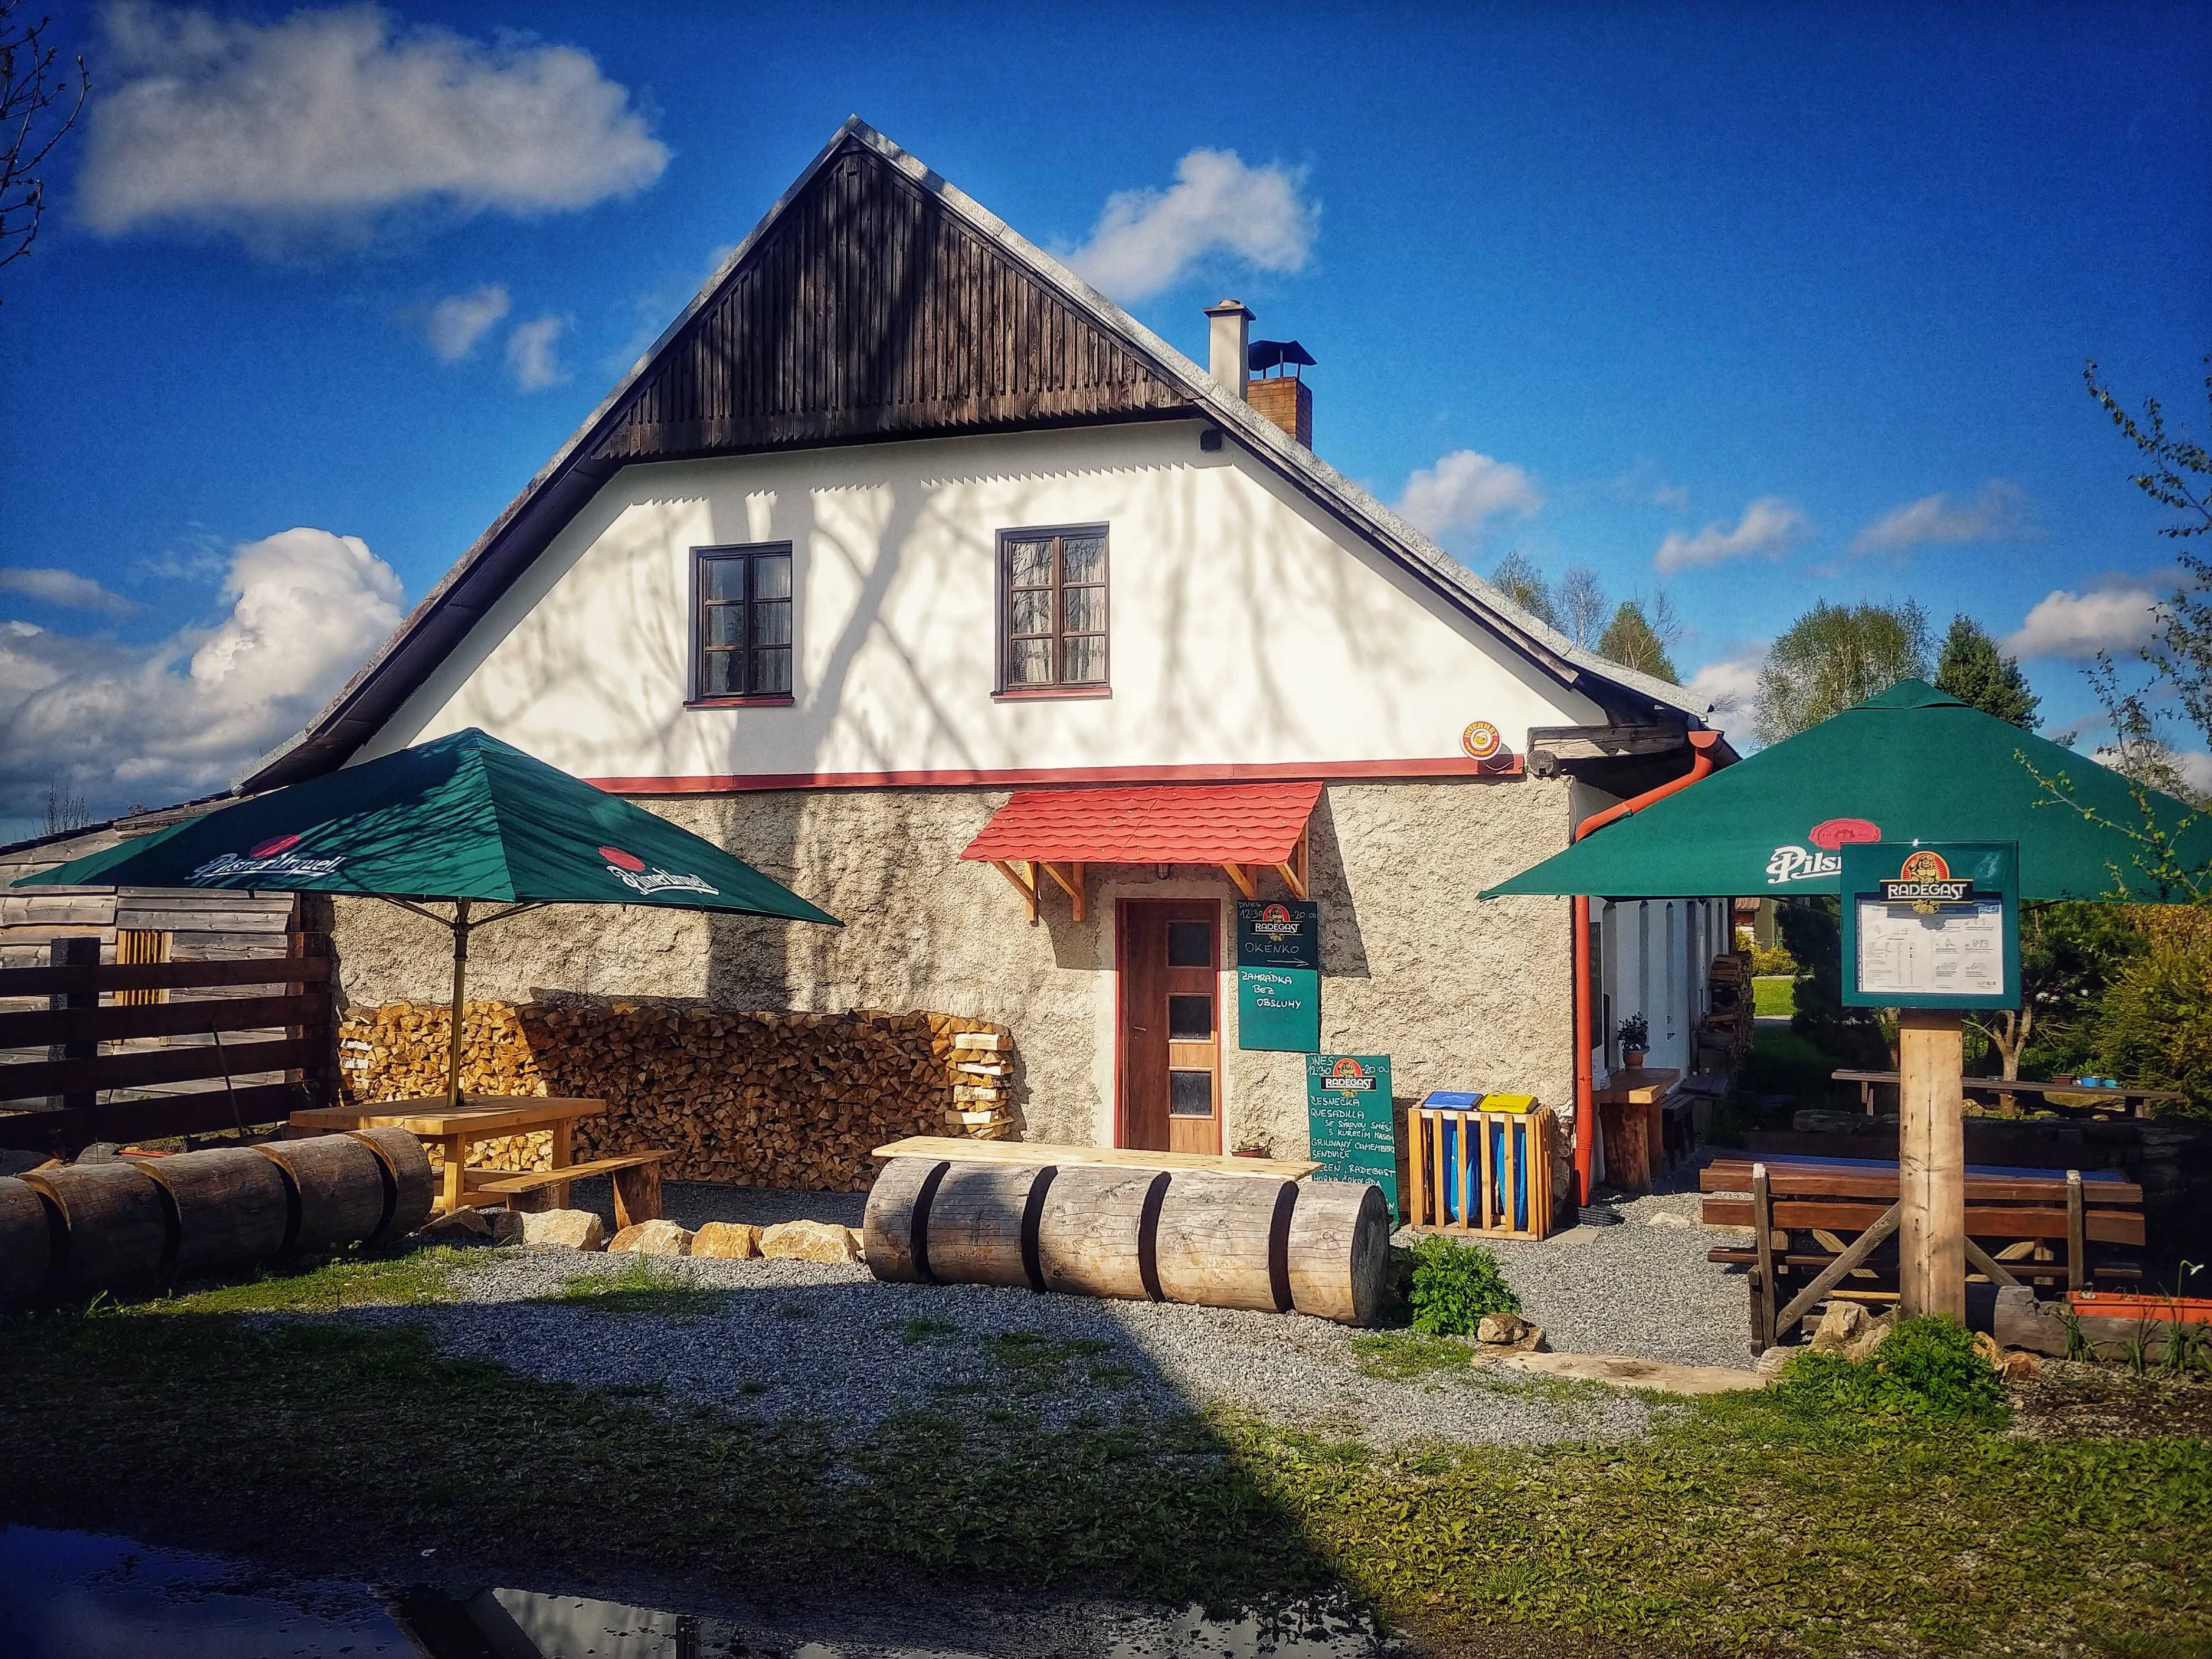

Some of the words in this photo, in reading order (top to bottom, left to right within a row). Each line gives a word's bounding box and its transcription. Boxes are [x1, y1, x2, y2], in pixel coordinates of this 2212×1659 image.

[1464, 722, 1498, 738] INTERNET
[184, 853, 278, 879] Pilsner
[267, 852, 347, 877] Urquell
[606, 866, 667, 895] Pilsner
[651, 867, 719, 894] Urquell
[1888, 883, 1967, 900] RADEGAST
[1239, 909, 1263, 919] 12:30
[1255, 923, 1299, 933] RADEGAST
[1245, 941, 1299, 953] OKÉNKO
[1241, 971, 1292, 984] ZAHRÁDKA
[1257, 998, 1302, 1009] OBSLUHY
[1307, 1066, 1331, 1076] 12:30
[1325, 1078, 1373, 1089] RADEGAST
[1310, 1095, 1360, 1107] ČESNEČKA
[1310, 1108, 1364, 1119] QUESADILLA
[1338, 1119, 1366, 1128] SÝROVOU
[1338, 1128, 1370, 1139] KUŘECÍM
[1374, 1132, 1394, 1144] MASEM
[1311, 1138, 1352, 1148] GRILOVANÝ
[1313, 1148, 1352, 1159] SENDVIČE
[1348, 1164, 1396, 1177] RADEGAST
[1314, 1173, 1338, 1182] HORKÁ
